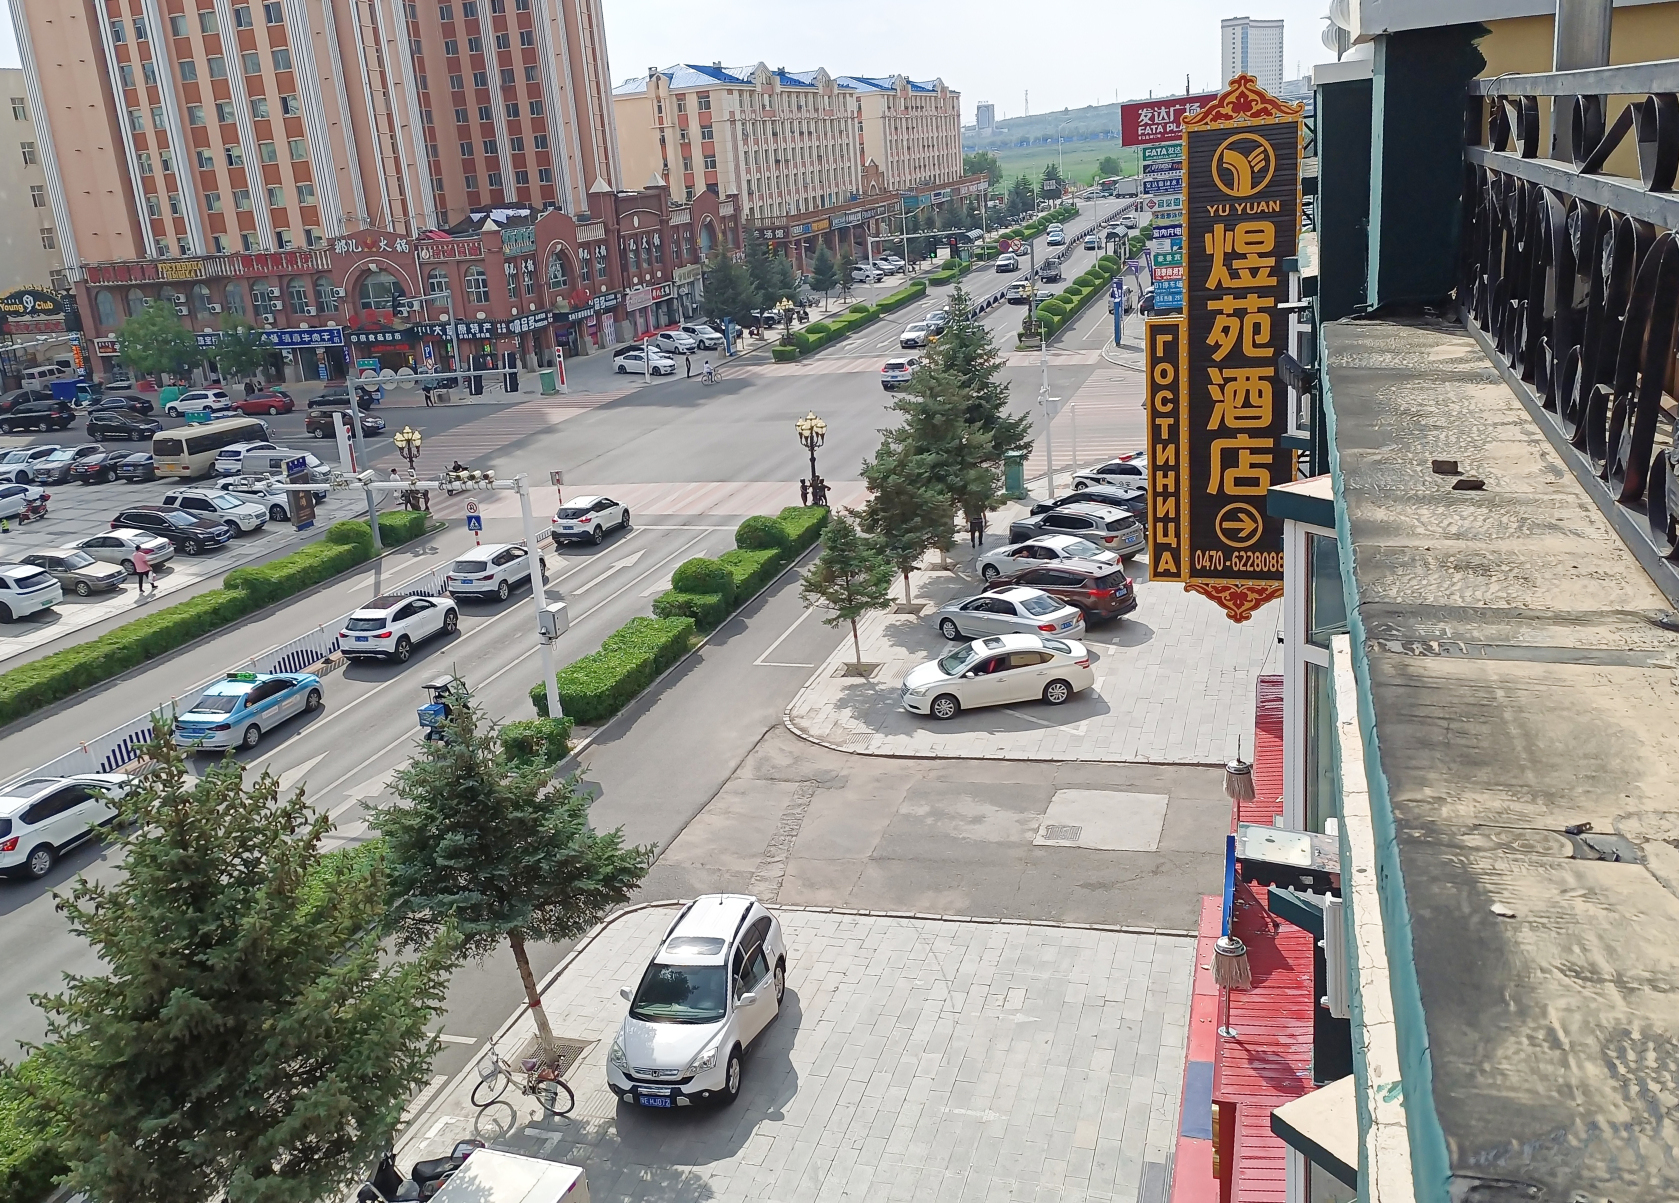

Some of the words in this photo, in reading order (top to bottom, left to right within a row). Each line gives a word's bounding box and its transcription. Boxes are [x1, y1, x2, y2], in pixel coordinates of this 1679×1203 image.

[1138, 124, 1163, 135] FATA
[1206, 206, 1231, 217] YU
[1236, 200, 1280, 214] YUAN
[0, 303, 24, 313] Young
[35, 301, 54, 310] Club
[1205, 221, 1278, 496] 煜苑酒店
[1153, 334, 1178, 573] ГОСТИНИЦА
[1195, 549, 1284, 572] 0470-6228088
